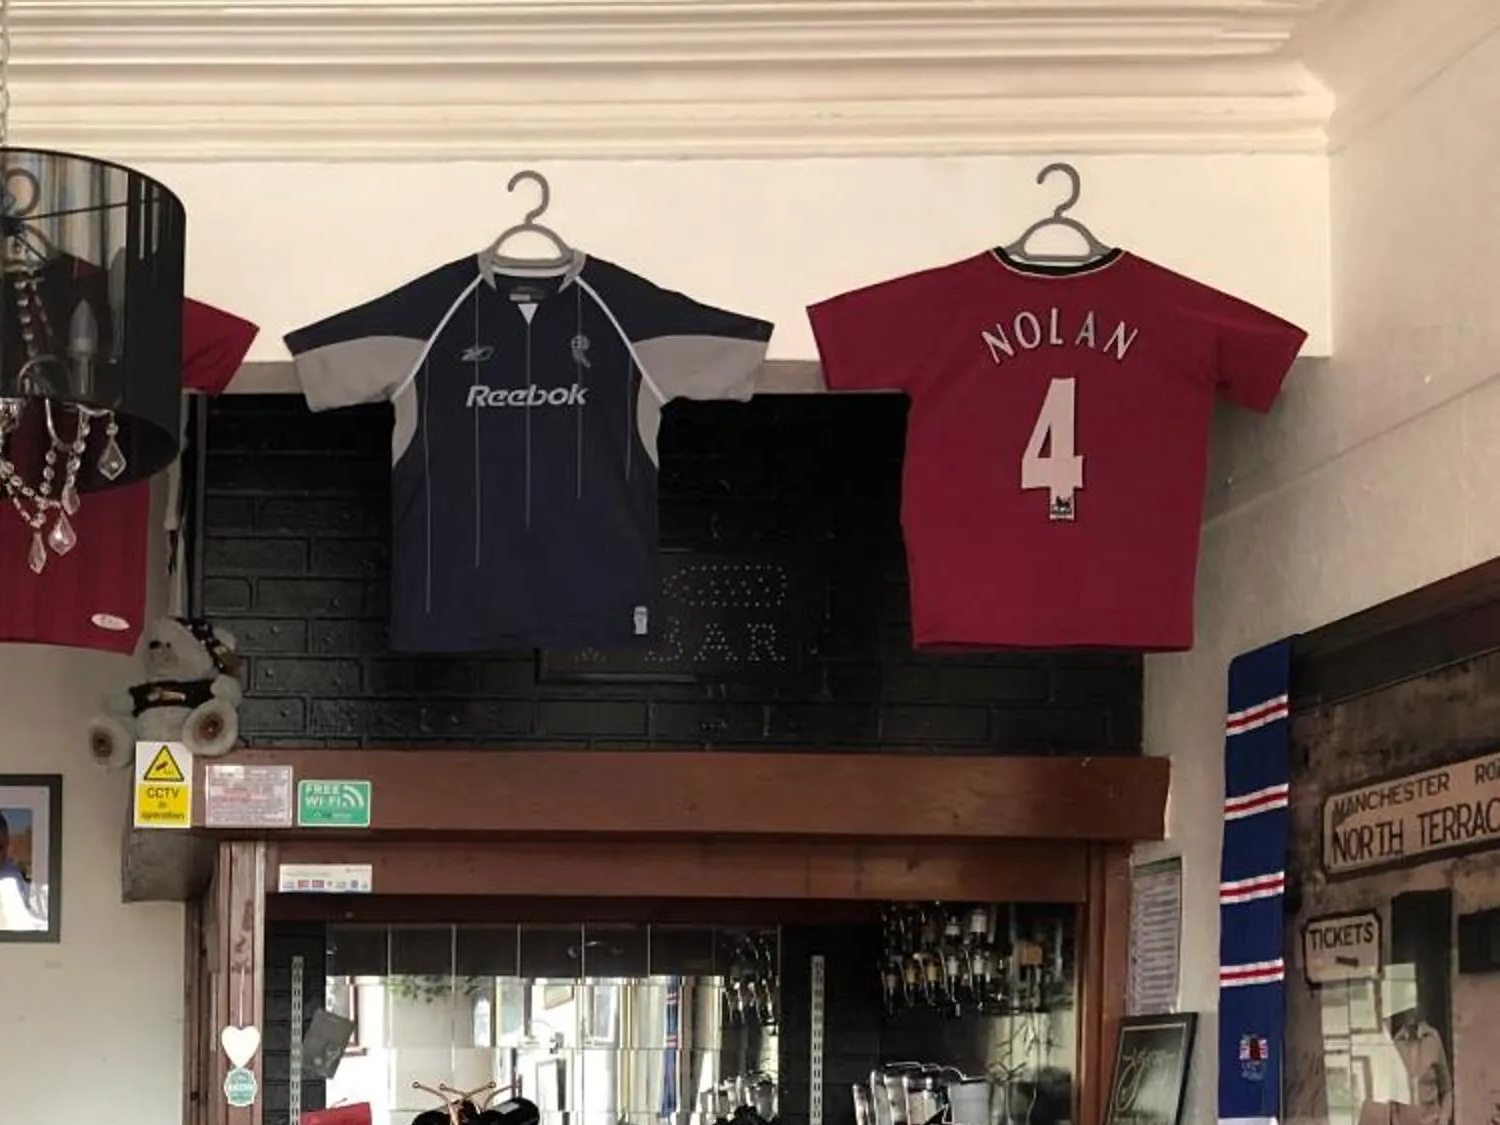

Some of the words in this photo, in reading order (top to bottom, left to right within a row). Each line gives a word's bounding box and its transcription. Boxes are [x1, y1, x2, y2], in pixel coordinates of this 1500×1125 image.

[981, 307, 1139, 364] NOLAN
[465, 383, 589, 408] Reebok
[1021, 377, 1083, 520] 4
[146, 787, 180, 799] CCTV
[305, 784, 340, 795] FREE
[1334, 772, 1450, 816] MANCHESTER
[1475, 761, 1500, 785] RO
[1332, 818, 1404, 865] NORTH
[1309, 922, 1374, 951] TICKETS
